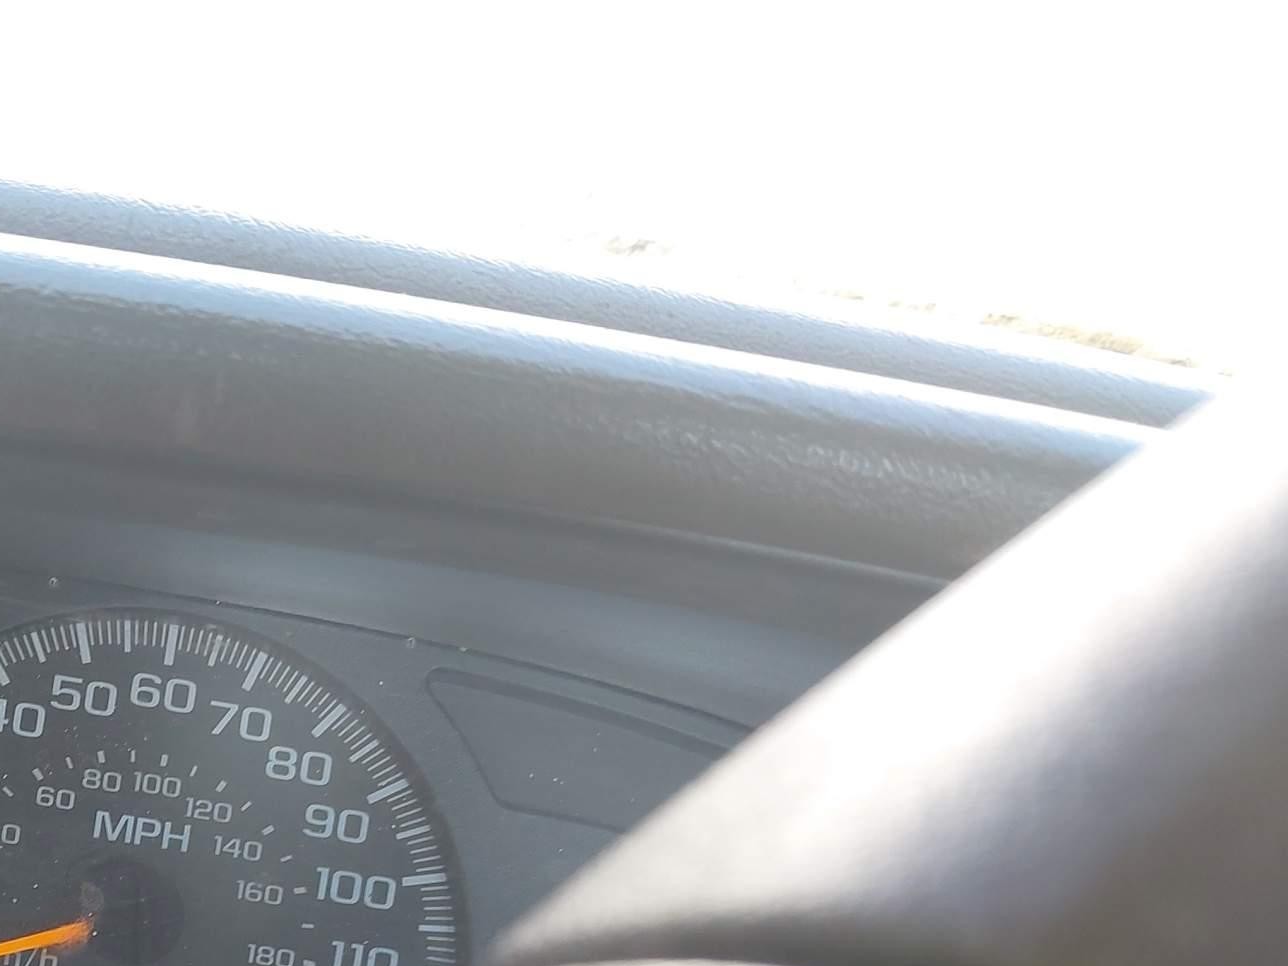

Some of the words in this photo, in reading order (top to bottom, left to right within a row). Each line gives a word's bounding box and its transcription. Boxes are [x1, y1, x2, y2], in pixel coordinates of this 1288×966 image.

[50, 674, 119, 717] 50
[129, 671, 198, 714] 60
[209, 700, 273, 743] 70
[81, 768, 122, 793] 80
[133, 772, 182, 798] 100
[264, 745, 334, 787] 80
[35, 786, 76, 810] 60
[184, 797, 233, 824] 120
[92, 810, 191, 852] MPH
[302, 804, 370, 844] 90
[213, 835, 264, 862] 140
[236, 879, 284, 906] 160
[314, 867, 397, 911] 100
